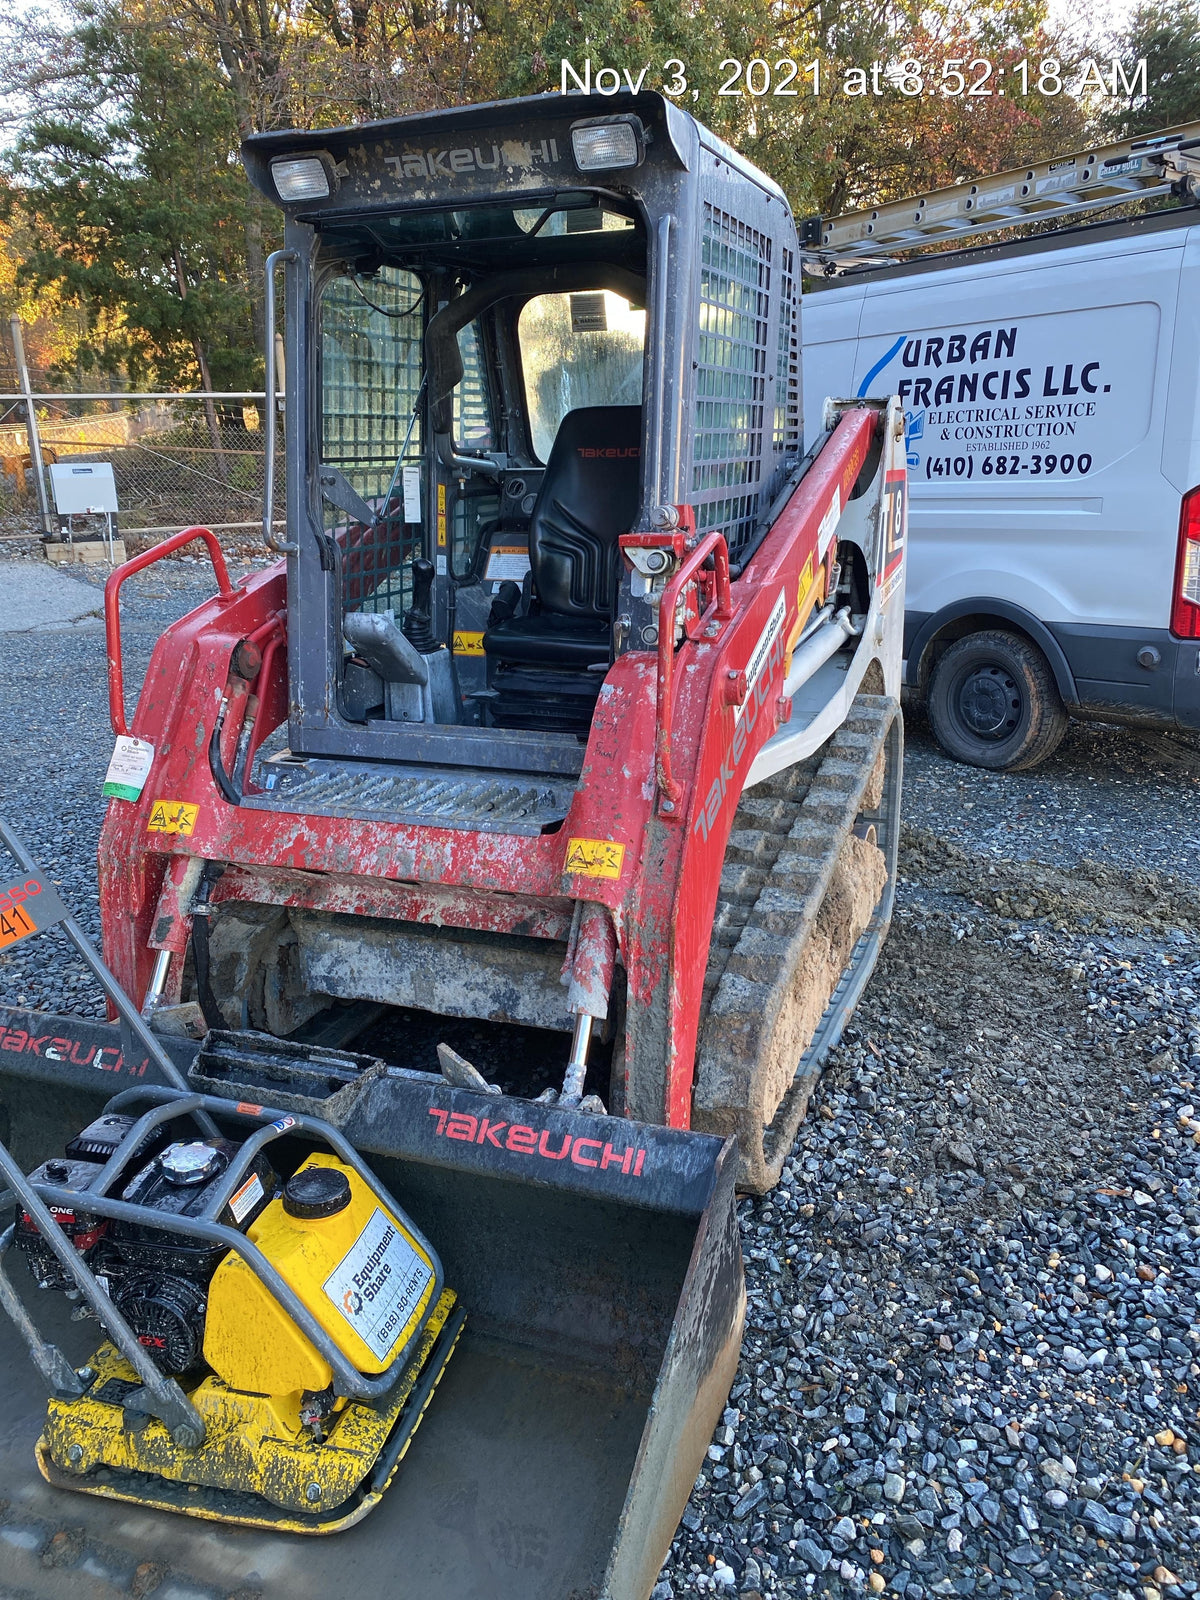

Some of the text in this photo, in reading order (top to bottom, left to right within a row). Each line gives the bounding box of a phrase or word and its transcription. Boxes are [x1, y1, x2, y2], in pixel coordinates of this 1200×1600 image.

[902, 327, 1018, 368] URBAN
[898, 361, 1112, 408] FRANCIS LLC.
[928, 401, 1097, 425] ELECTRICAL SERVICE
[940, 421, 1077, 441] & CONSTRUCTION
[577, 447, 641, 459] TAKEUC
[925, 453, 1093, 480] (410) 682-3900
[966, 440, 1051, 453] ESTABLISHED 1962
[739, 601, 786, 708] quipmentShare
[351, 1225, 396, 1290] Equipment
[363, 1262, 392, 1303] Share
[377, 1267, 424, 1344] (888) 80-RENTS
